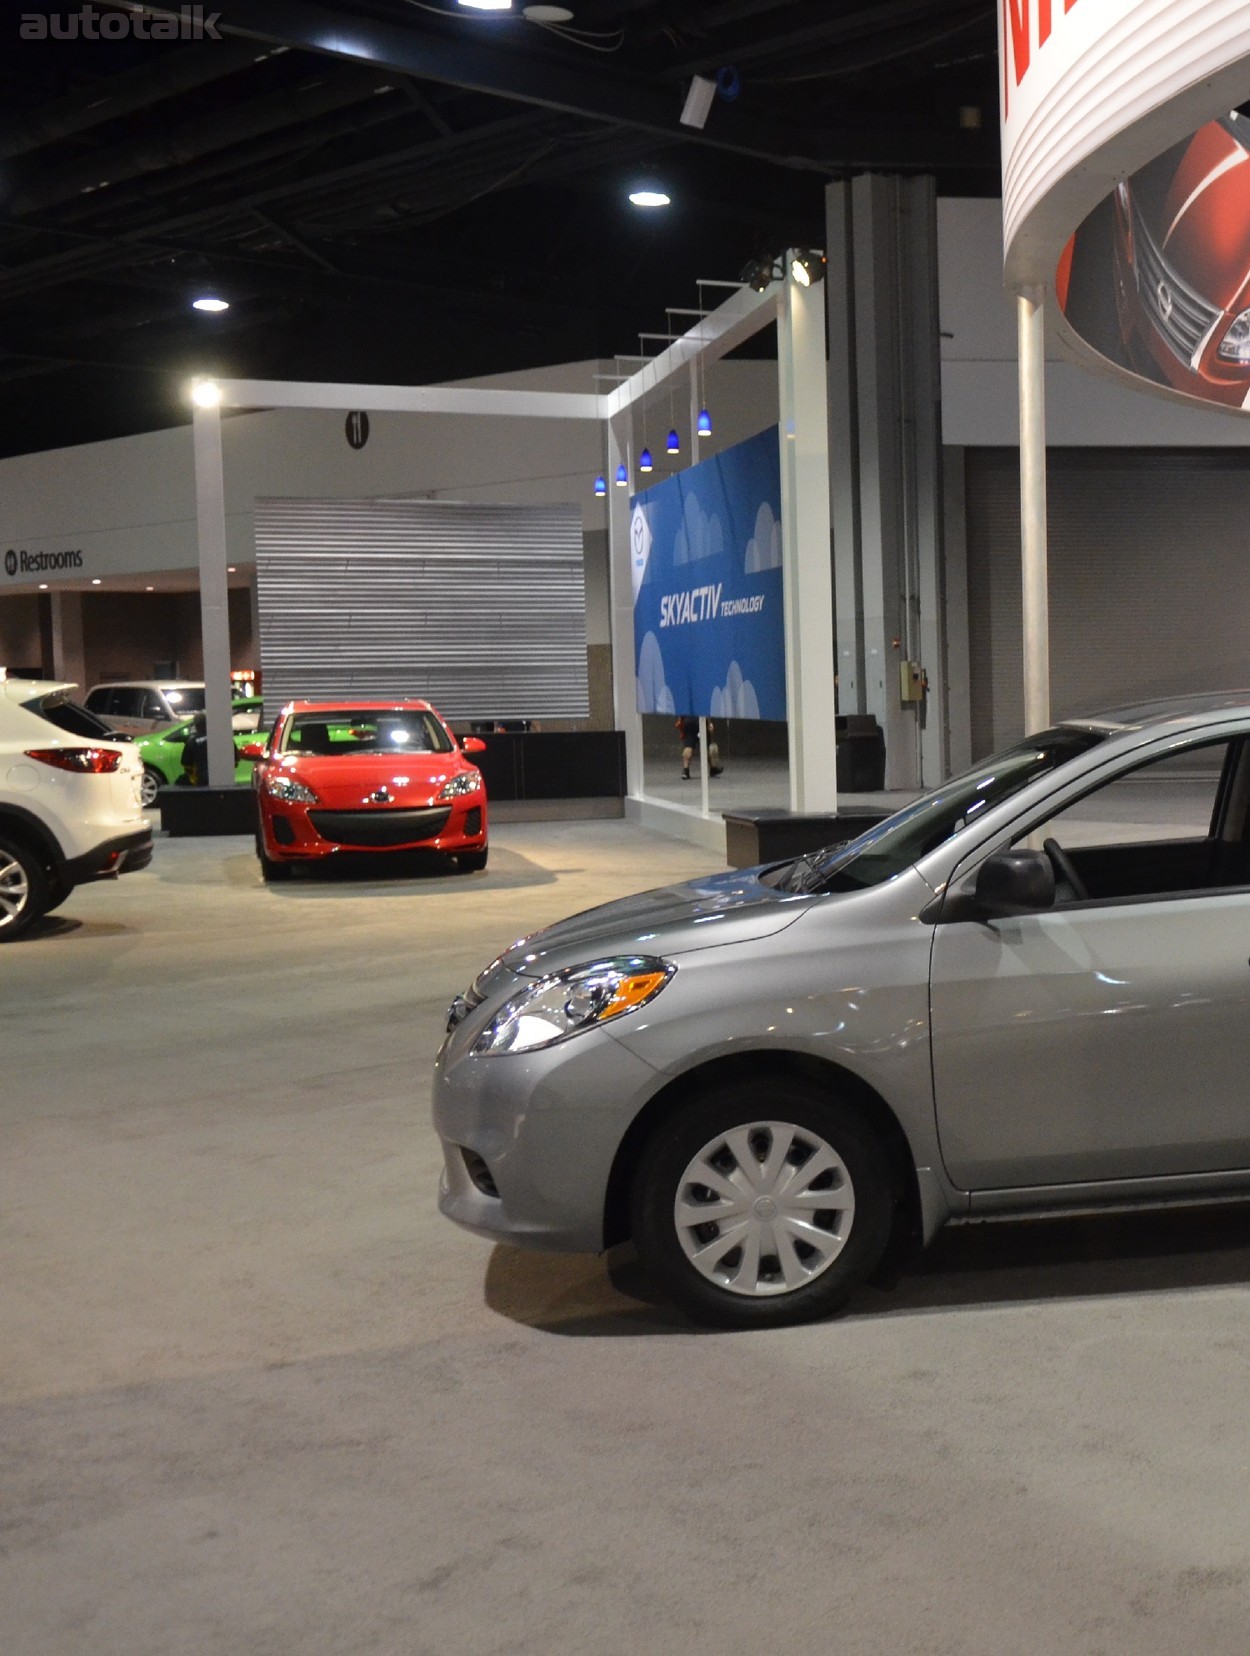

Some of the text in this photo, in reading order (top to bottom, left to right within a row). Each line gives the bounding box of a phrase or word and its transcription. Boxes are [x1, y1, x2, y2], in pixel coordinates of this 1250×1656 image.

[20, 550, 83, 572] Restrooms
[660, 583, 764, 627] SKYACTIV TECHNOLOGY
